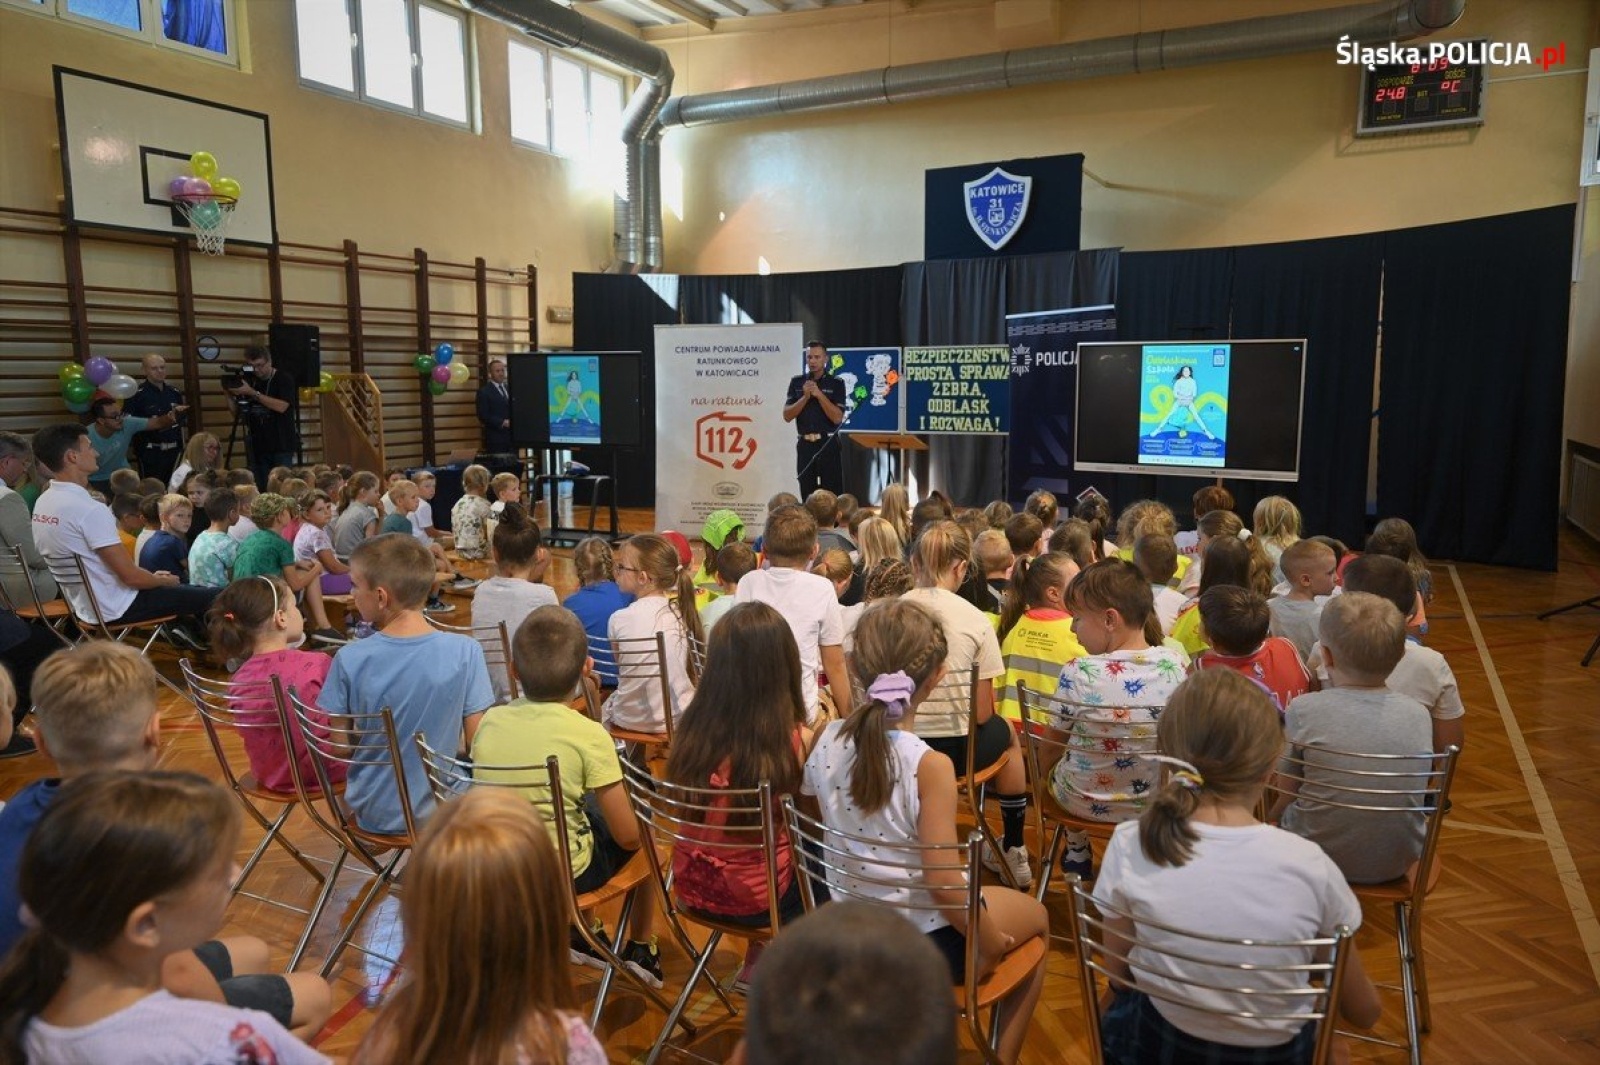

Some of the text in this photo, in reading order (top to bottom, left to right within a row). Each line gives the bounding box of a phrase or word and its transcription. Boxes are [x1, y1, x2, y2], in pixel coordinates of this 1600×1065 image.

[969, 183, 1024, 198] KATOWICE
[989, 198, 1002, 208] 31
[675, 345, 780, 354] CENTRUM POWIADAMIANIA
[697, 357, 758, 365] RATUNKOWEGO
[696, 369, 760, 377] W KATOWICACH
[906, 366, 955, 381] PROSTA
[932, 382, 986, 398] ZEBRA,
[691, 395, 763, 406] na ratunek
[928, 398, 990, 414] ODBLASK
[919, 415, 926, 430] I
[705, 426, 744, 453] 112
